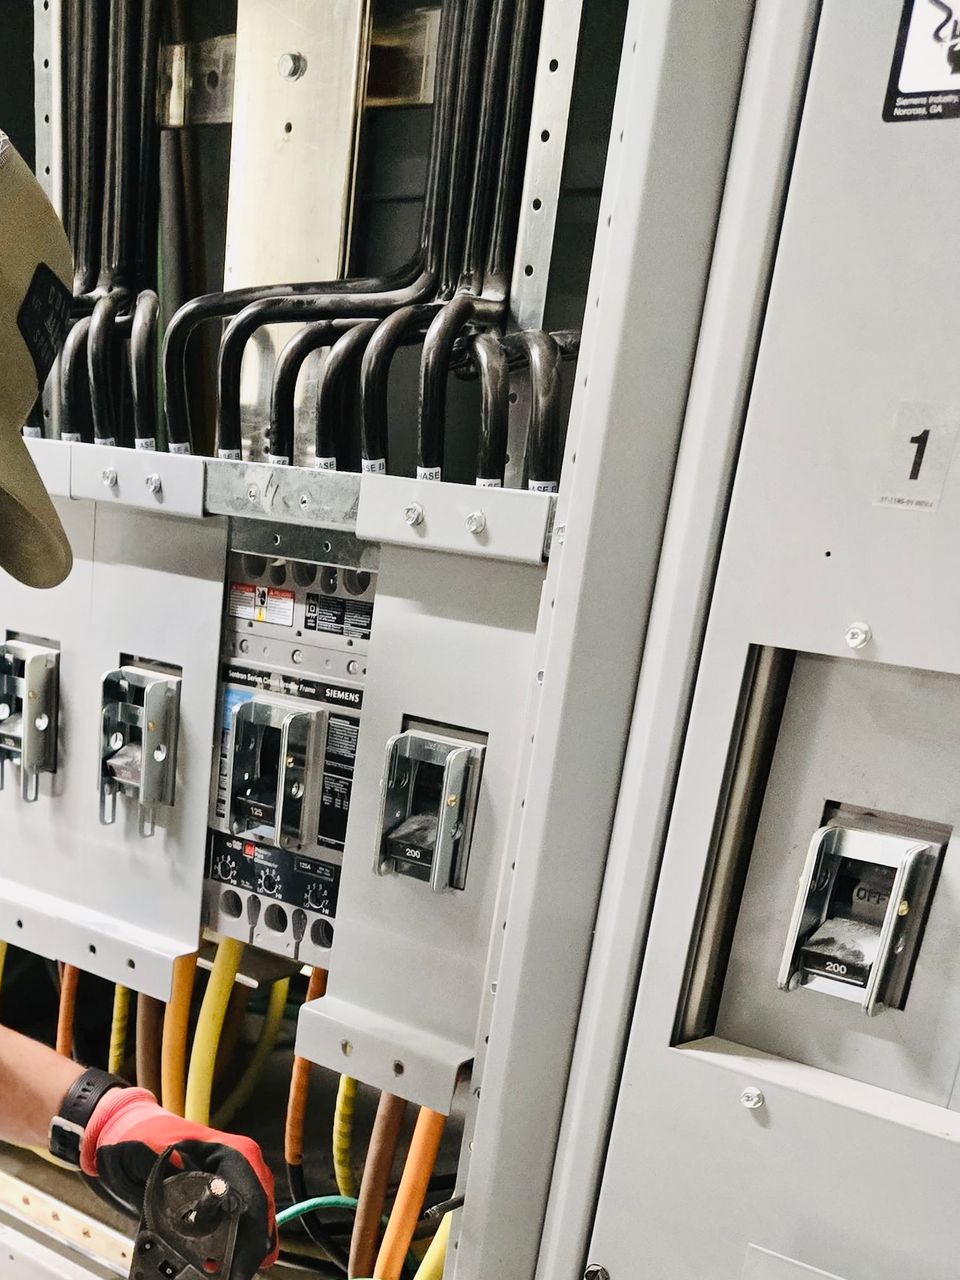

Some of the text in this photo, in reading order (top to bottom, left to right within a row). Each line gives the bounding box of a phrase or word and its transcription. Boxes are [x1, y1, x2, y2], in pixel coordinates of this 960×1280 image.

[929, 104, 942, 114] GA
[909, 428, 930, 480] 1
[325, 688, 360, 703] SIEMENS
[250, 806, 263, 816] 125
[406, 848, 420, 859] 200
[856, 887, 890, 905] OFF
[825, 962, 847, 975] 200
